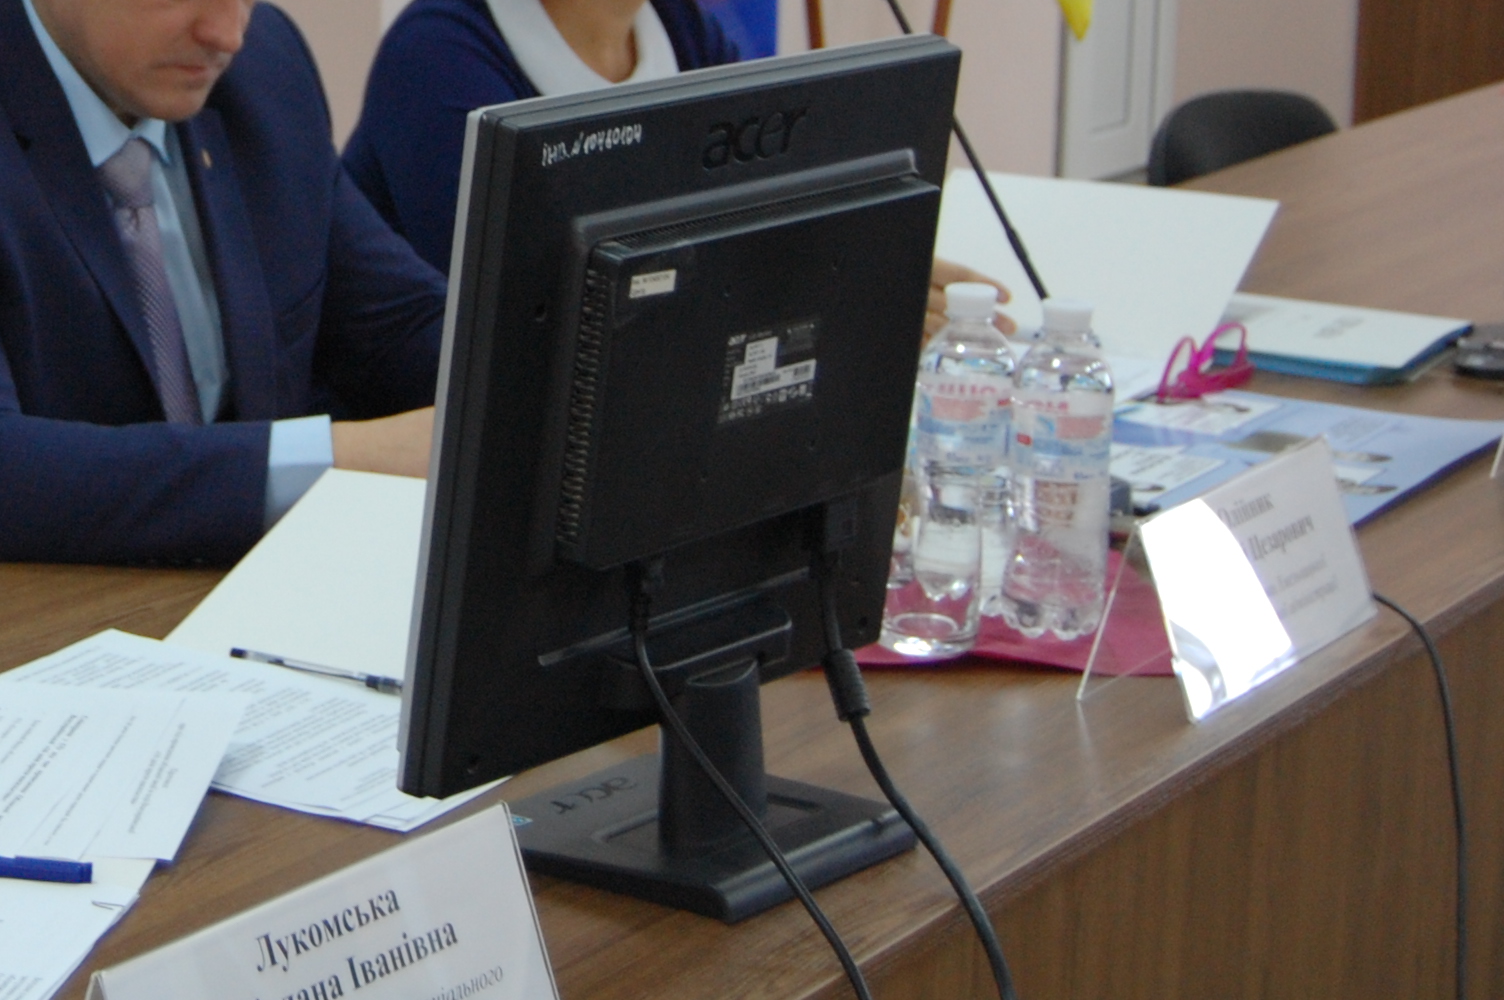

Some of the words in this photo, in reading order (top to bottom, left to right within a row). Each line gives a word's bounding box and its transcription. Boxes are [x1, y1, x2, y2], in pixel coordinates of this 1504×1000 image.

[701, 108, 809, 172] acer
[254, 888, 401, 973] Лукомська
[346, 921, 459, 991] Іванівна
